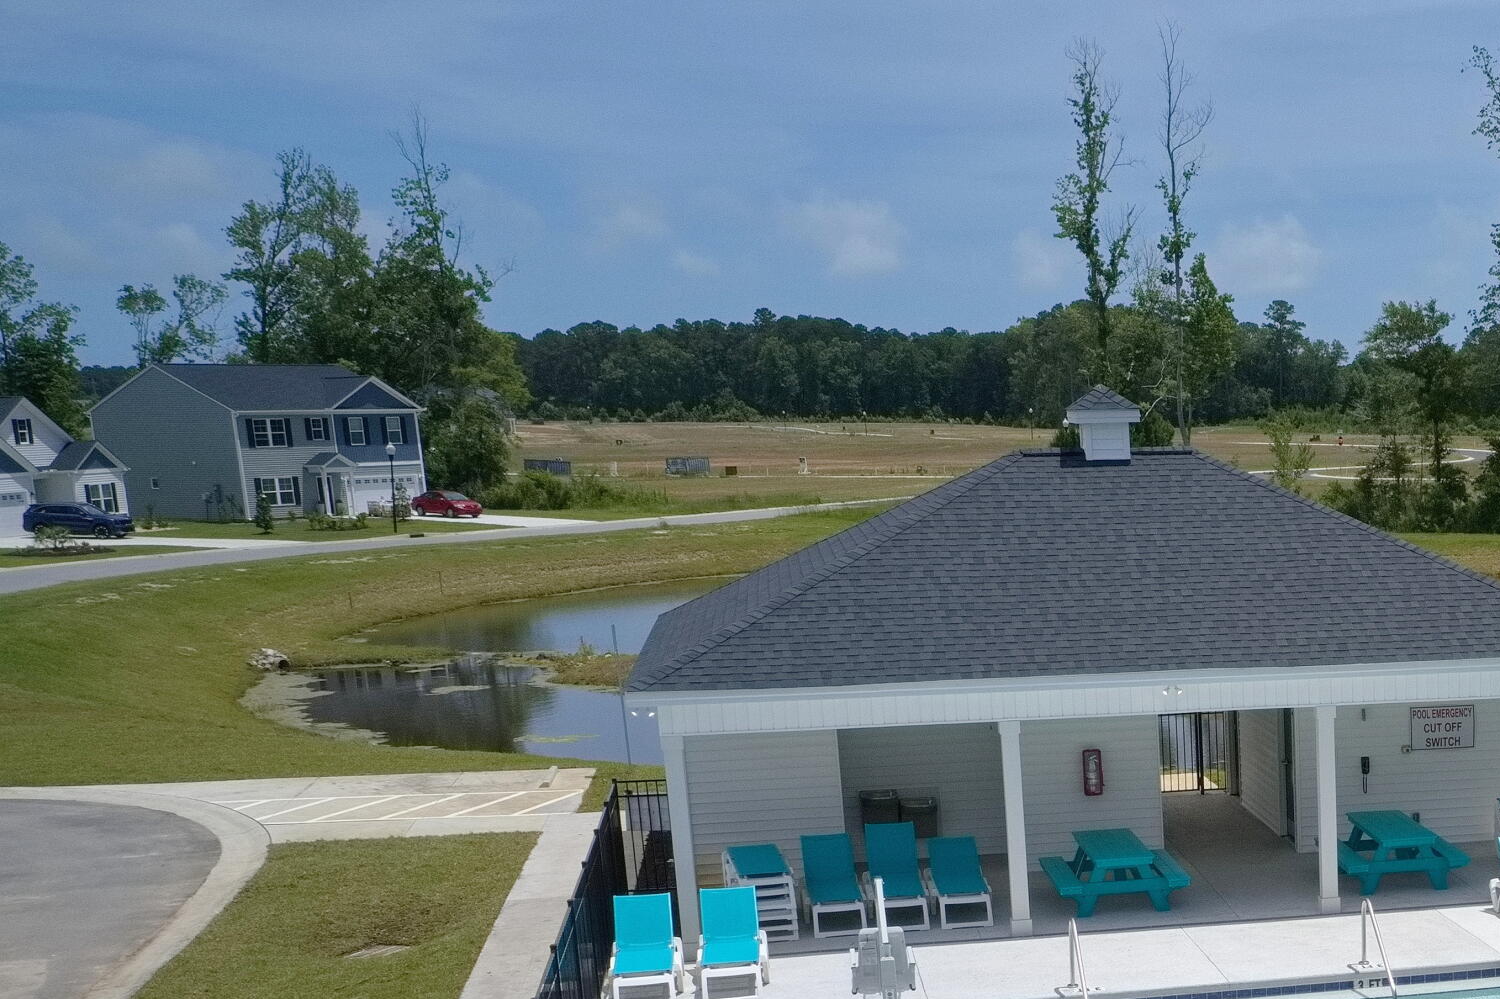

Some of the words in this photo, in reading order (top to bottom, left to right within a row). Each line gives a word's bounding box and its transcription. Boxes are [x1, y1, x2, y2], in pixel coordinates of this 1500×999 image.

[1413, 709, 1430, 719] POOL
[1432, 707, 1472, 718] EMERGENCY
[1424, 723, 1442, 733] CUT
[1445, 722, 1462, 732] OFF
[1425, 736, 1460, 747] SWITCH
